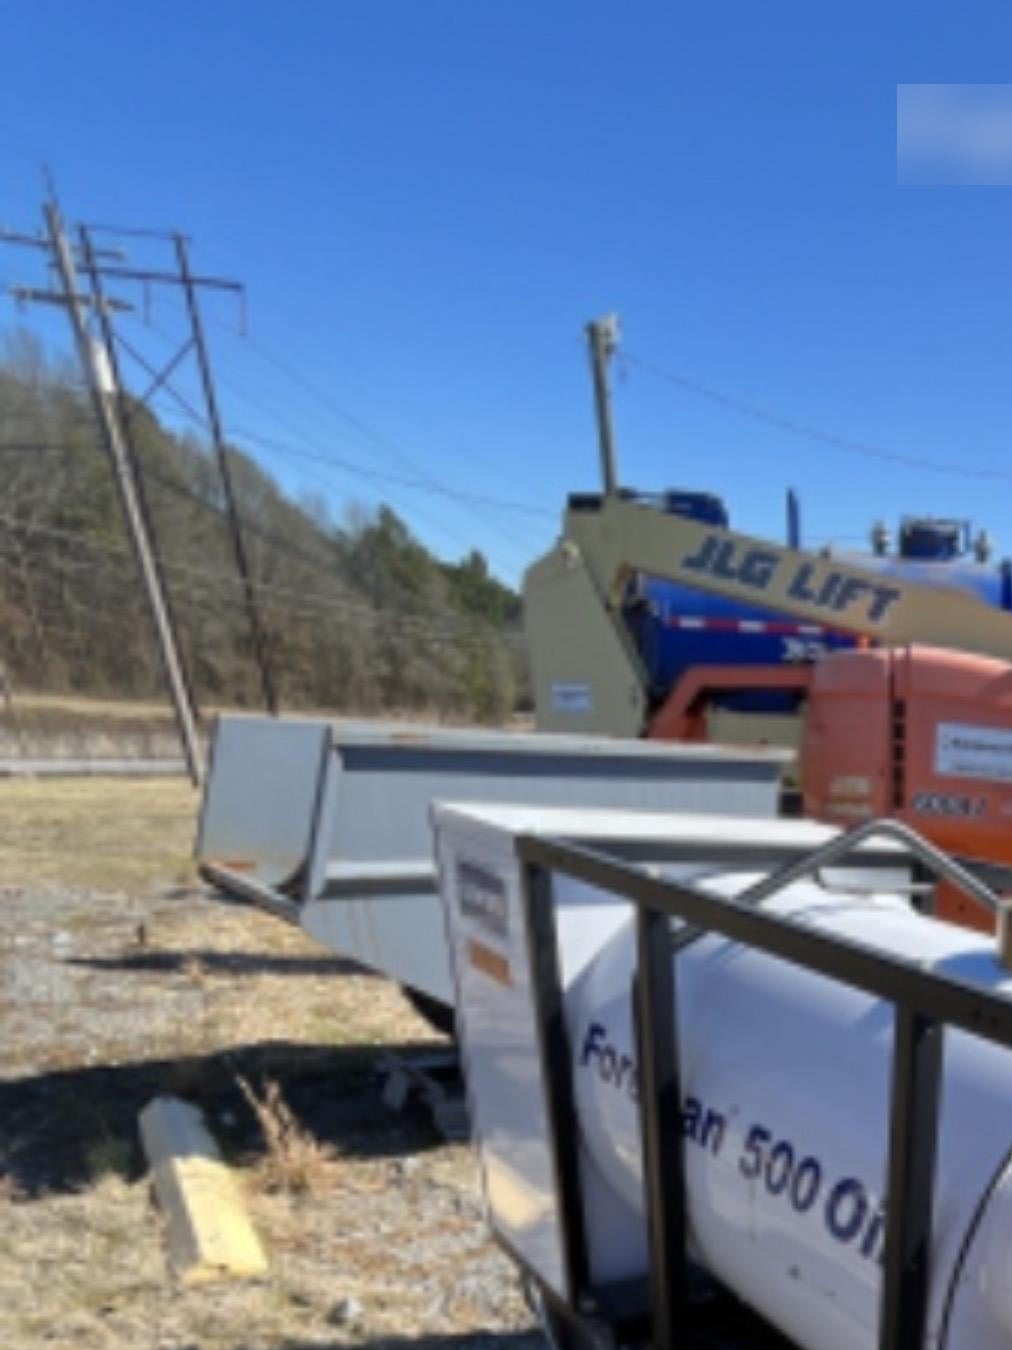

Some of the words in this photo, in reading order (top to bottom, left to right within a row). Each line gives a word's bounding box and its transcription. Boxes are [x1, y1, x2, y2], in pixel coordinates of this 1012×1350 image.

[681, 535, 780, 590] JLG
[786, 562, 901, 622] LIFT
[738, 1123, 821, 1213] 500
